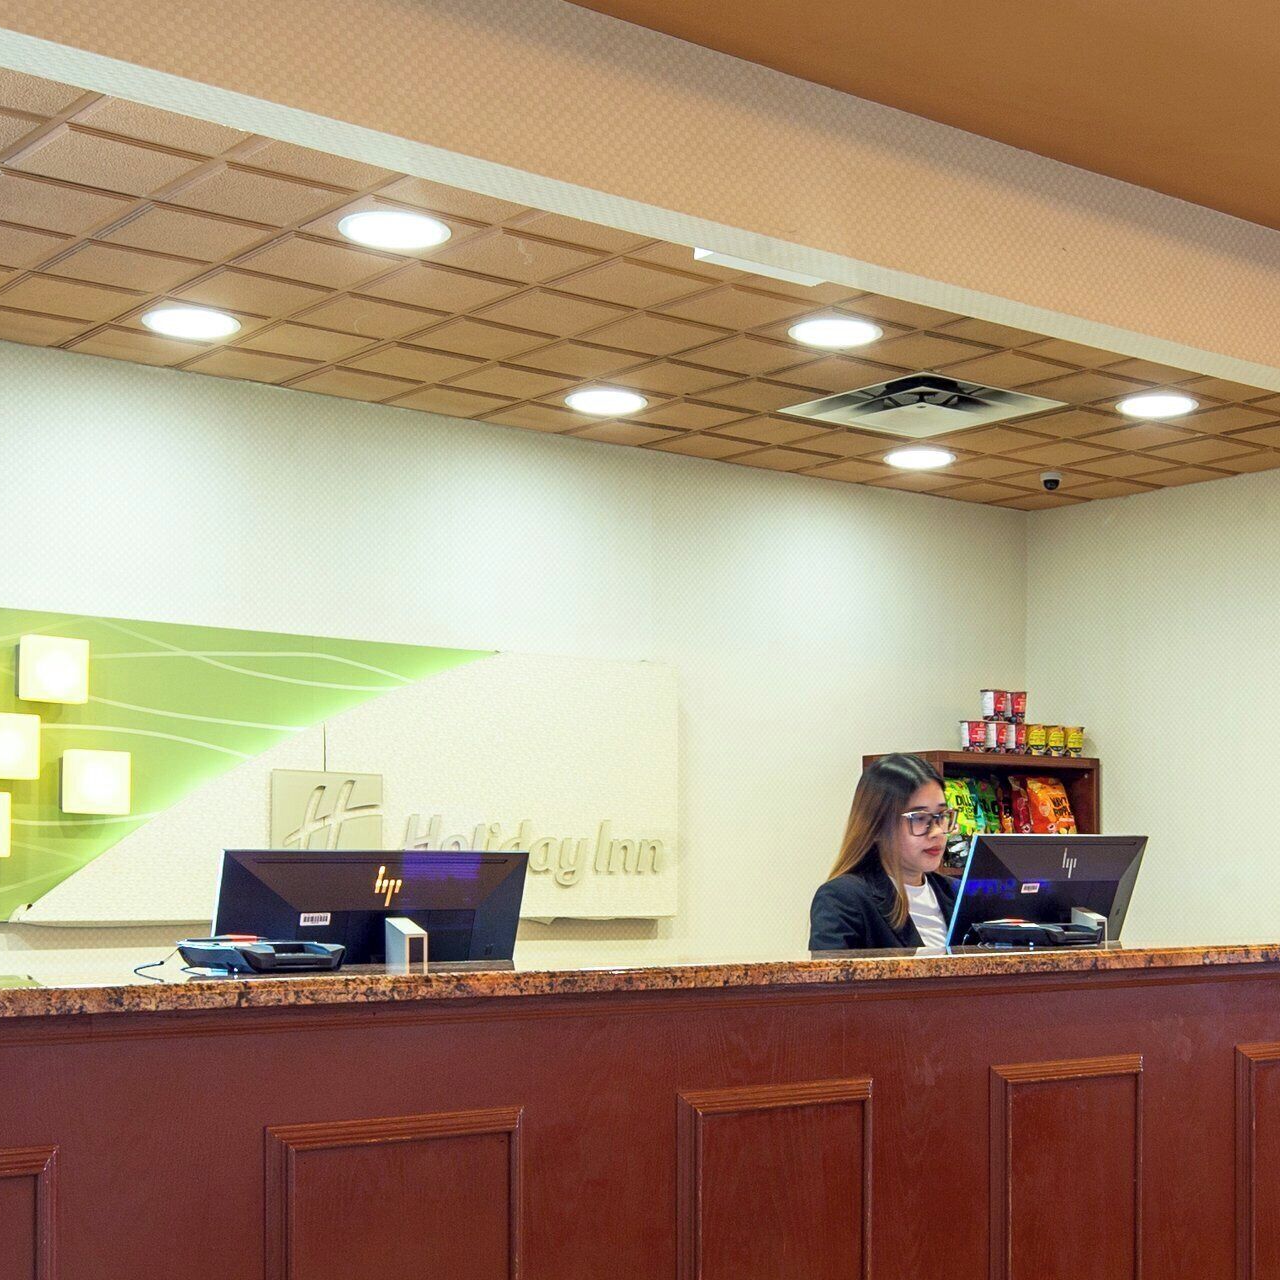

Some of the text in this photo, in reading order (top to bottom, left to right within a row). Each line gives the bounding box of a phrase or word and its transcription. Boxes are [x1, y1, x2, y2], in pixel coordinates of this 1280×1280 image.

[593, 819, 663, 873] Inn
[1062, 847, 1077, 878] hp
[374, 865, 402, 907] hp
